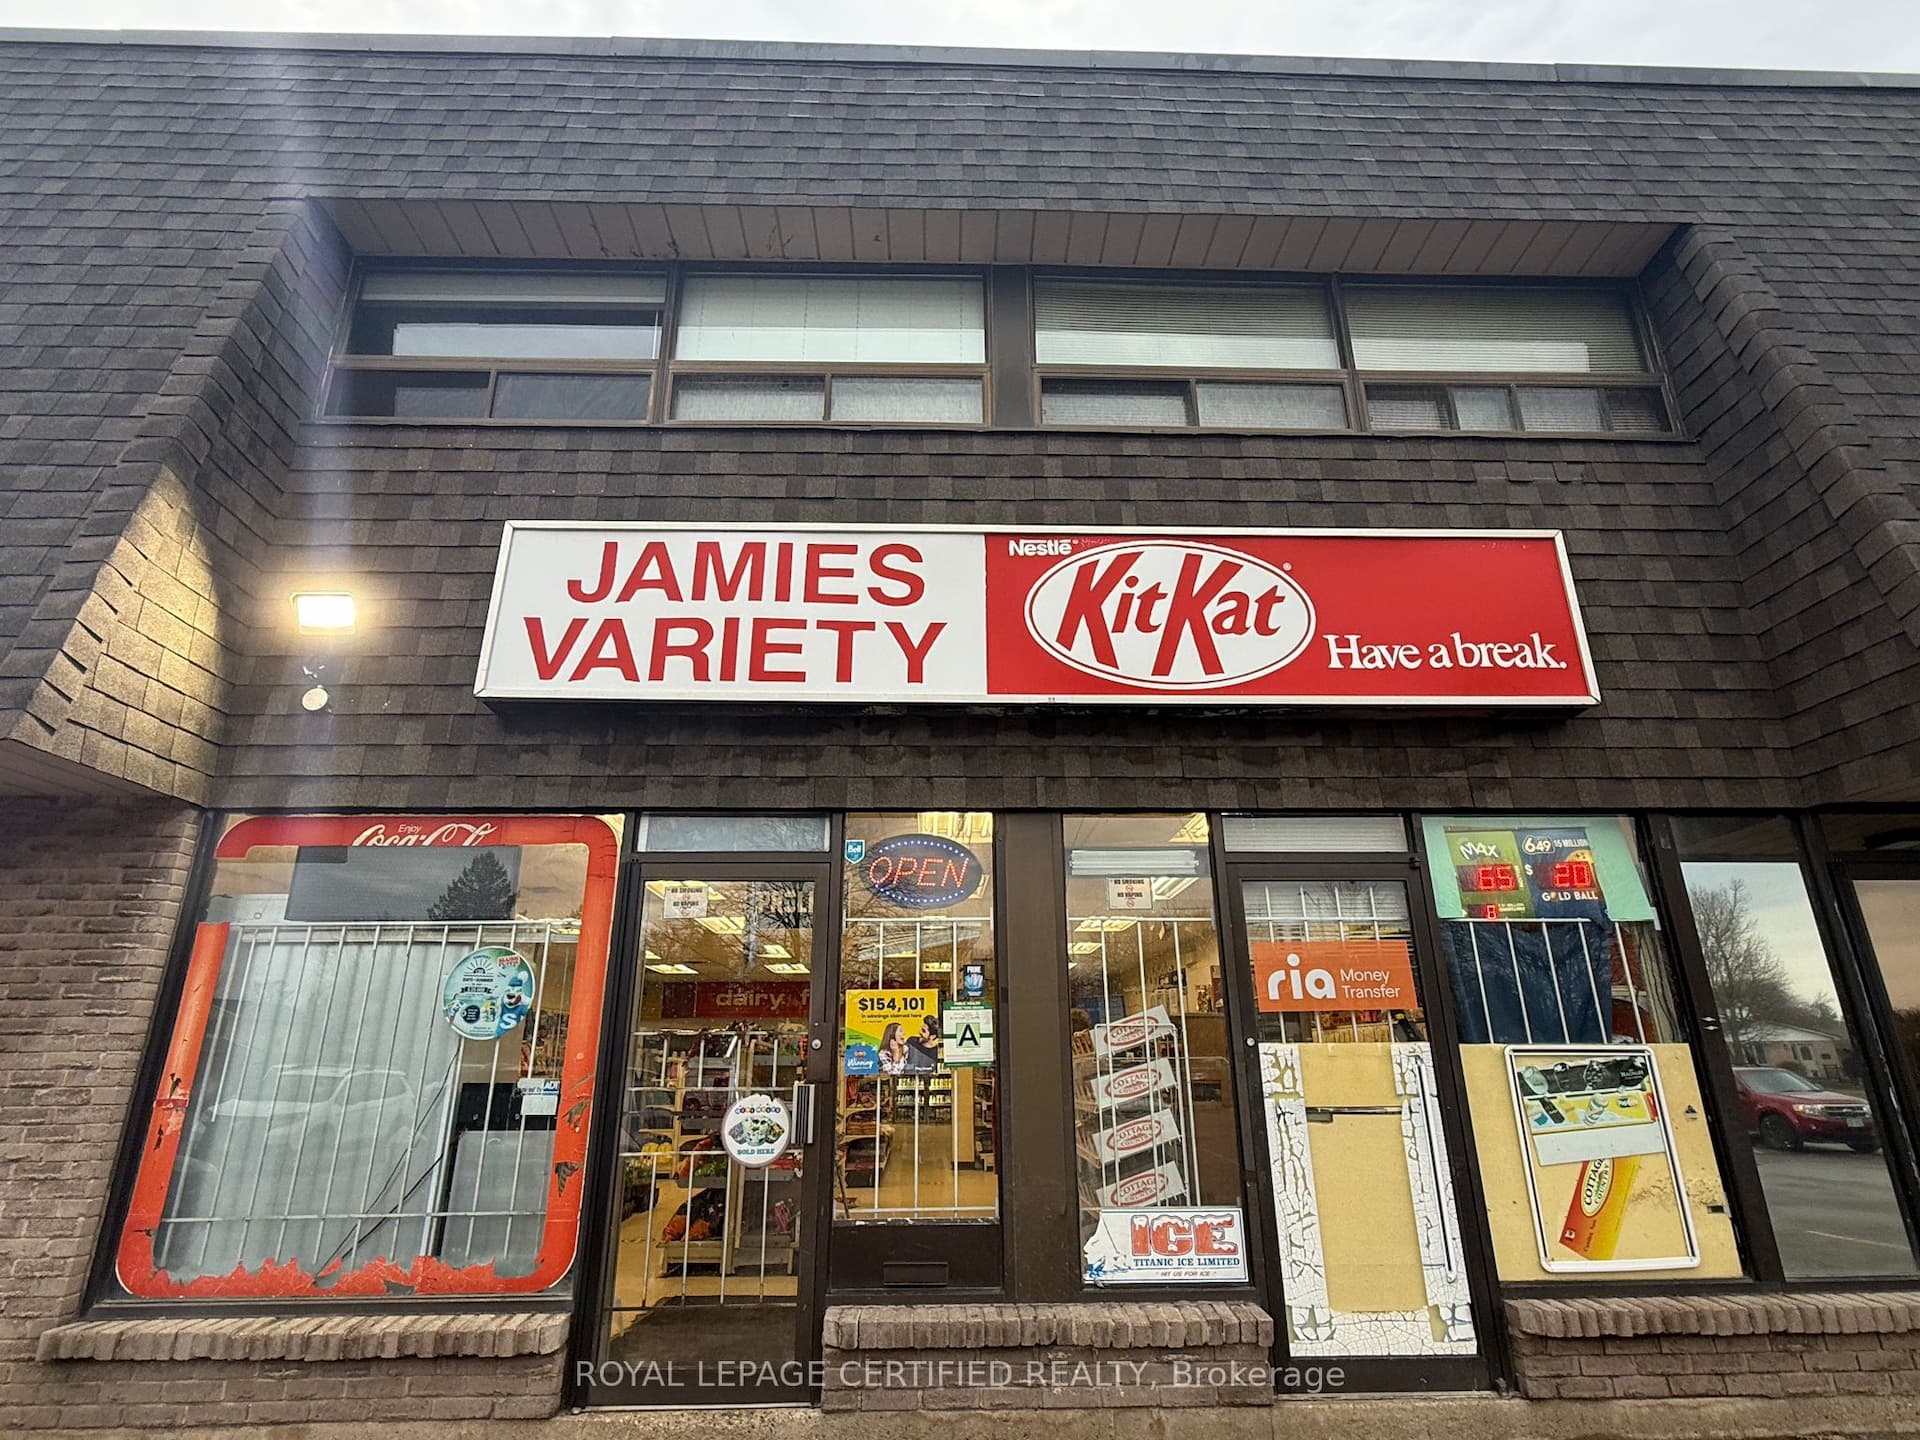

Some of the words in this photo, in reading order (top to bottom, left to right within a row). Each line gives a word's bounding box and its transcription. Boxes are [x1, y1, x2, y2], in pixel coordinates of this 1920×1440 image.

[567, 541, 926, 606] JAMIES
[1055, 551, 1286, 677] KitKat
[523, 616, 948, 684] VARIETY
[1322, 634, 1423, 670] Have
[1428, 643, 1453, 669] a
[1450, 632, 1568, 669] break.
[398, 823, 423, 834] Enjoy
[847, 844, 861, 853] Bell
[868, 856, 970, 888] OPEN
[1480, 866, 1515, 890] 65
[1554, 863, 1590, 888] 20
[1574, 891, 1599, 901] BALL
[1486, 904, 1497, 920] 8
[1267, 953, 1337, 1001] ria
[1340, 968, 1390, 983] Money
[715, 989, 785, 1011] dairy
[1342, 985, 1401, 999] Transfer
[858, 997, 926, 1013] $154,101
[958, 1024, 980, 1046] A
[847, 1058, 874, 1070] Winning
[1594, 1163, 1610, 1204] COUNTRY
[1130, 1213, 1240, 1257] ICE
[1133, 1259, 1174, 1267] TITANIC
[1177, 1259, 1195, 1267] ICE
[1197, 1257, 1240, 1266] LIMITED
